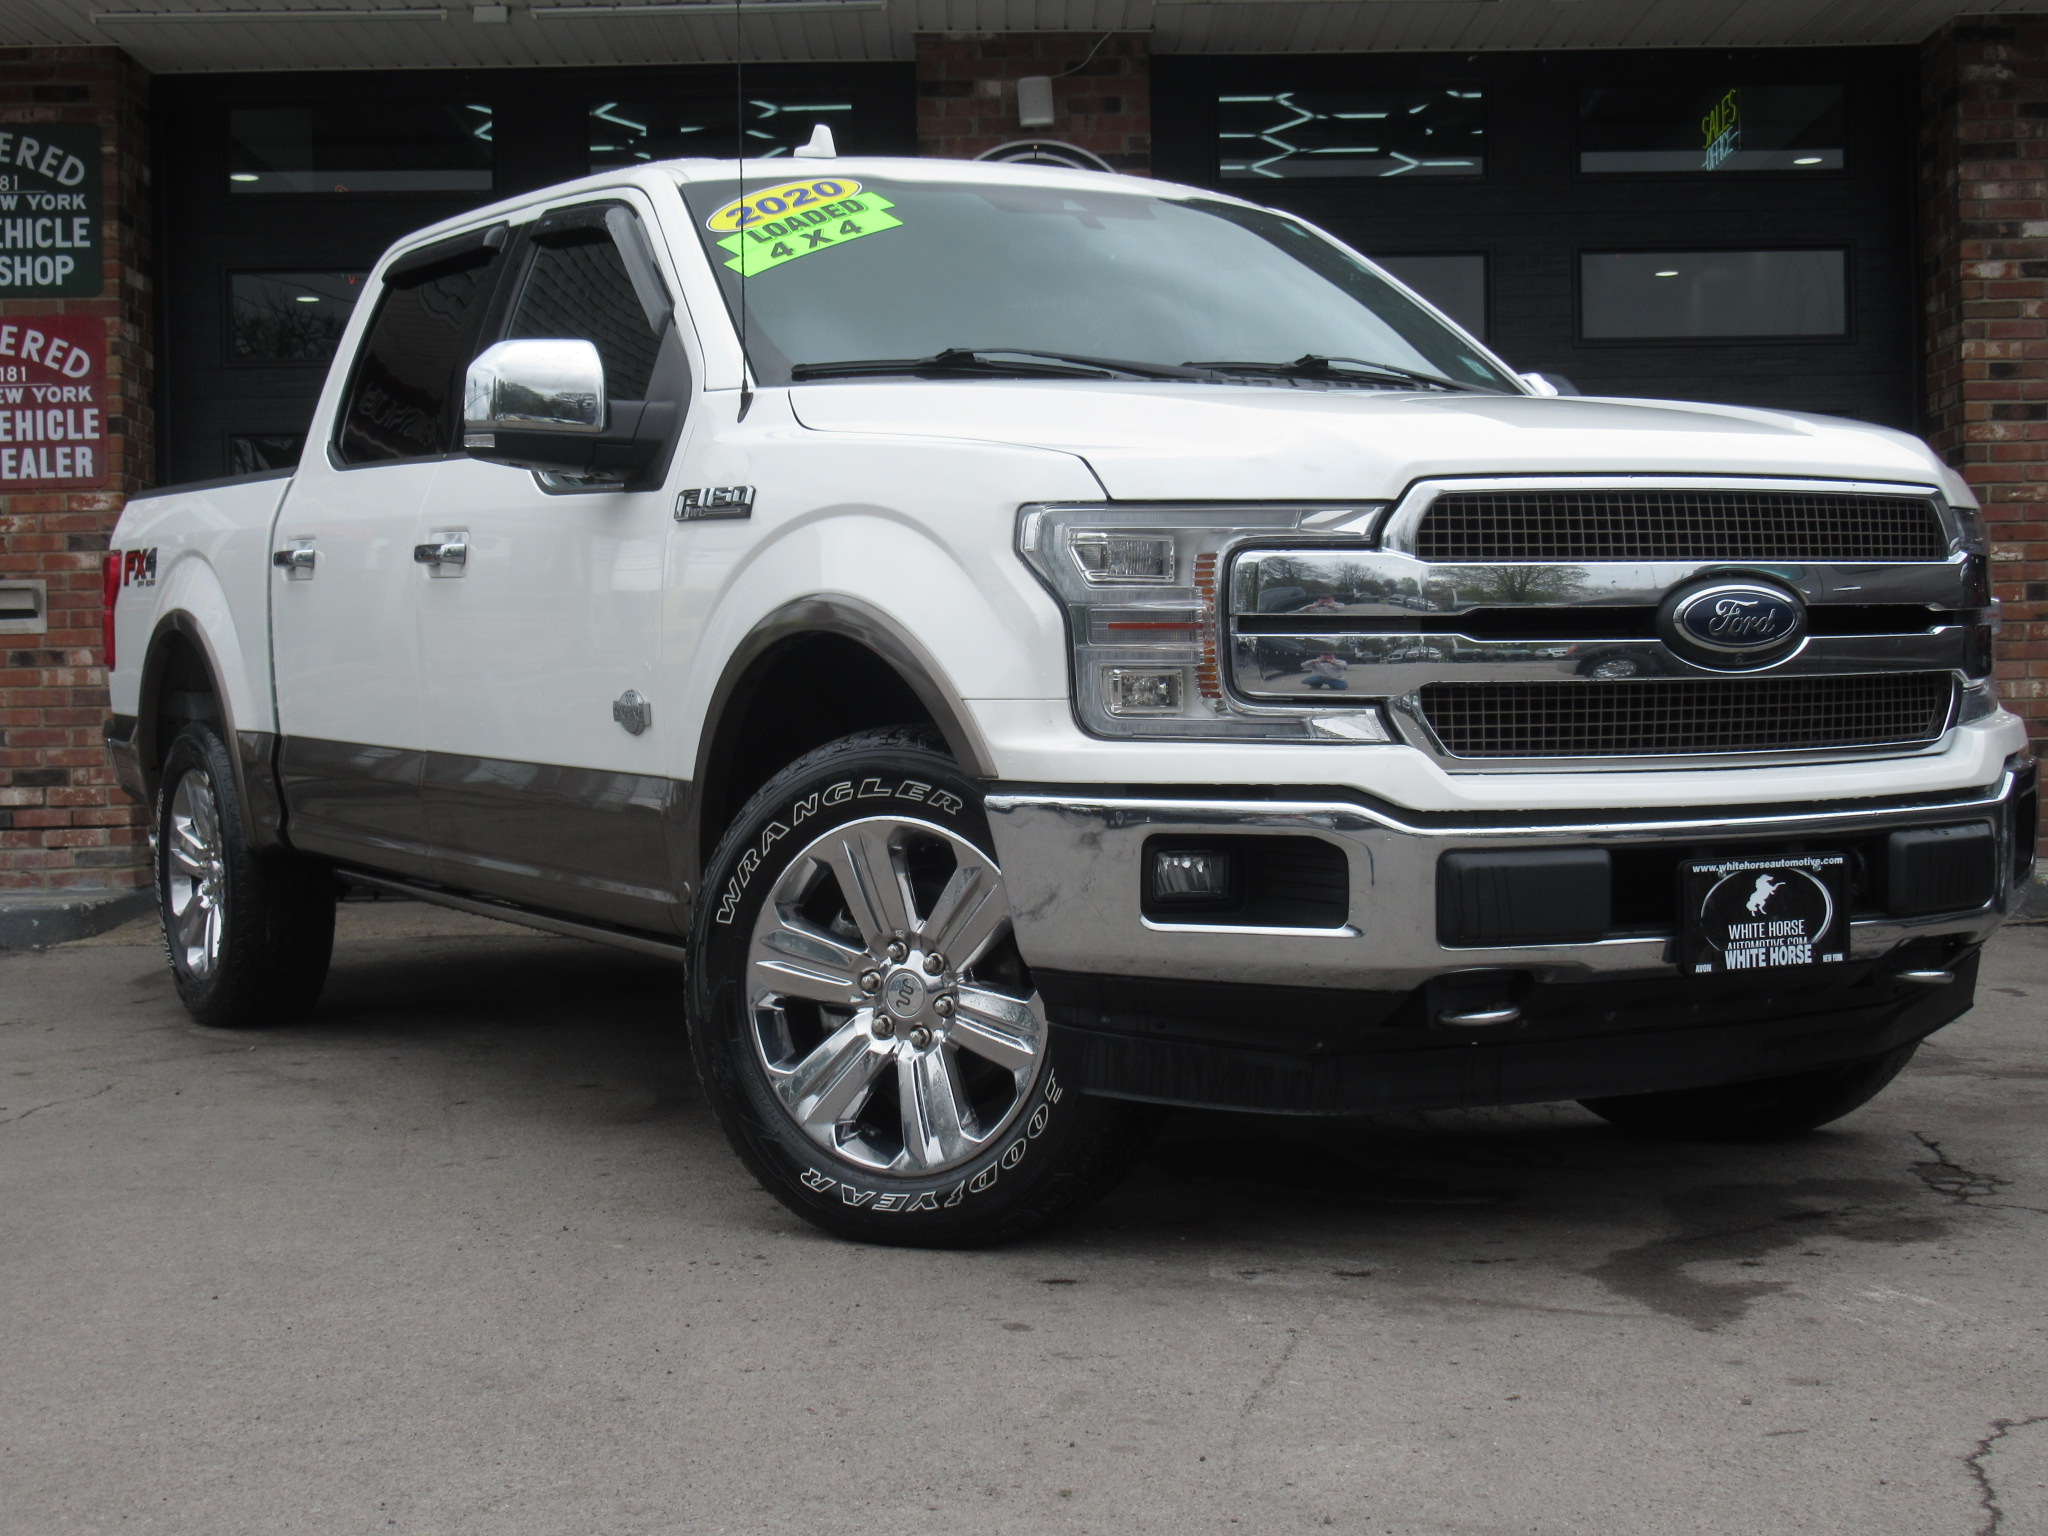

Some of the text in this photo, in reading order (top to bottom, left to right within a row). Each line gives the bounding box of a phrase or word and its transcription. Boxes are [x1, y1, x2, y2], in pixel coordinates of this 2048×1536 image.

[1702, 89, 1737, 149] SALES
[0, 132, 85, 186] ERED
[26, 193, 87, 210] YORK
[726, 181, 844, 227] 2020
[0, 217, 91, 248] HICLE
[747, 199, 869, 243] LOADED
[0, 255, 75, 286] SHOP
[0, 325, 90, 378] ERED
[0, 386, 93, 404] W YORK
[2, 446, 94, 479] EALER
[123, 547, 158, 587] FX4
[1708, 598, 1776, 636] Ford
[716, 778, 963, 924] WRANGLER
[1692, 856, 1843, 873] www.whitehorseautomotive.com
[1728, 919, 1805, 940] WHITE HORSE
[1695, 964, 1712, 974] AVON
[1725, 944, 1812, 970] WHITE HORSE
